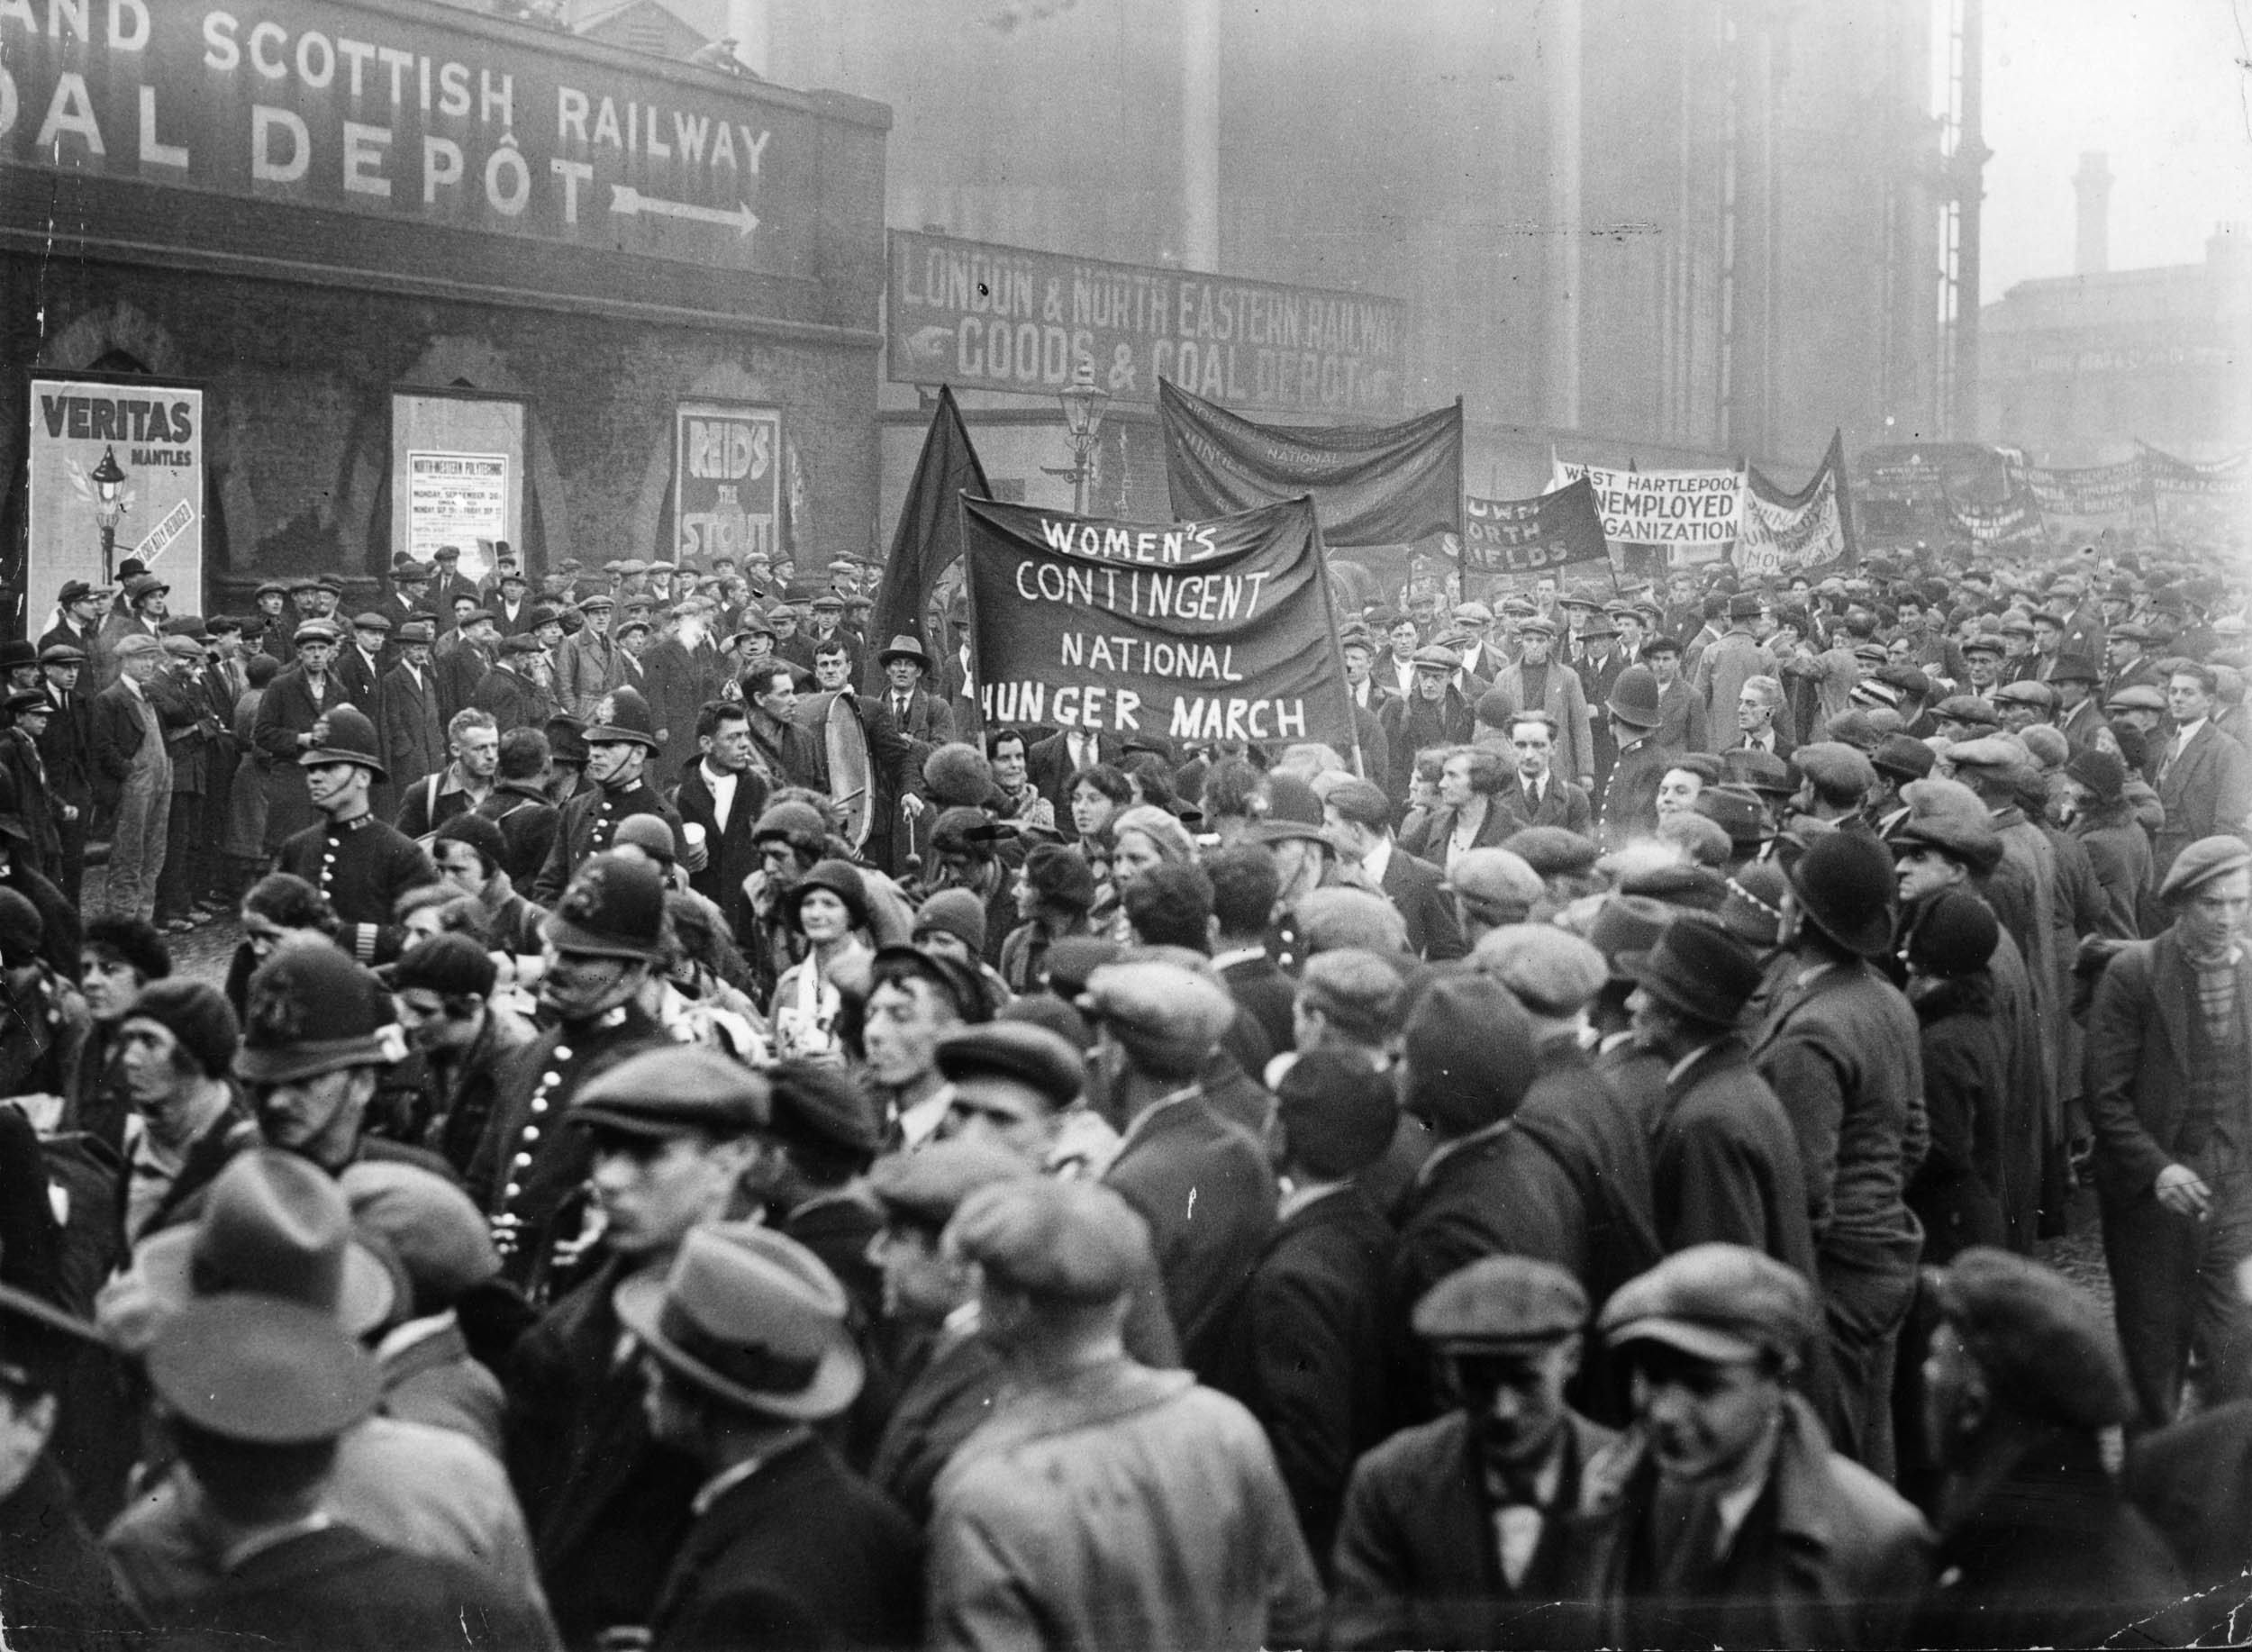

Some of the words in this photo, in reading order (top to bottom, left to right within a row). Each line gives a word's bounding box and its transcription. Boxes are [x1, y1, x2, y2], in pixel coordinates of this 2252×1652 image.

[202, 11, 513, 125] SCOTTISH
[558, 86, 771, 174] RAILWAY
[251, 104, 594, 224] DEPÔT
[902, 243, 1033, 318] LONDON
[1044, 278, 1064, 322] &
[1073, 270, 1168, 334] NORTH
[1178, 280, 1299, 347] EASTERN
[958, 316, 1096, 385] GOODS
[1108, 343, 1137, 391] &
[41, 395, 192, 443] VERITAS
[132, 449, 191, 467] MANTLES
[689, 421, 768, 479] REID'S
[1593, 488, 1734, 520] NEMPLOYED
[1627, 476, 1741, 493] HARTLEPOOL
[683, 513, 772, 555] STOUT
[1041, 520, 1217, 563] WOMEN'S
[1467, 521, 1540, 544] ORTH
[1603, 517, 1739, 541] GANIZATION
[1017, 561, 1270, 621] CONTINGENT
[1062, 632, 1242, 681] NATIONAL
[982, 681, 1140, 731] HUNGER
[1170, 696, 1305, 741] MARCH
